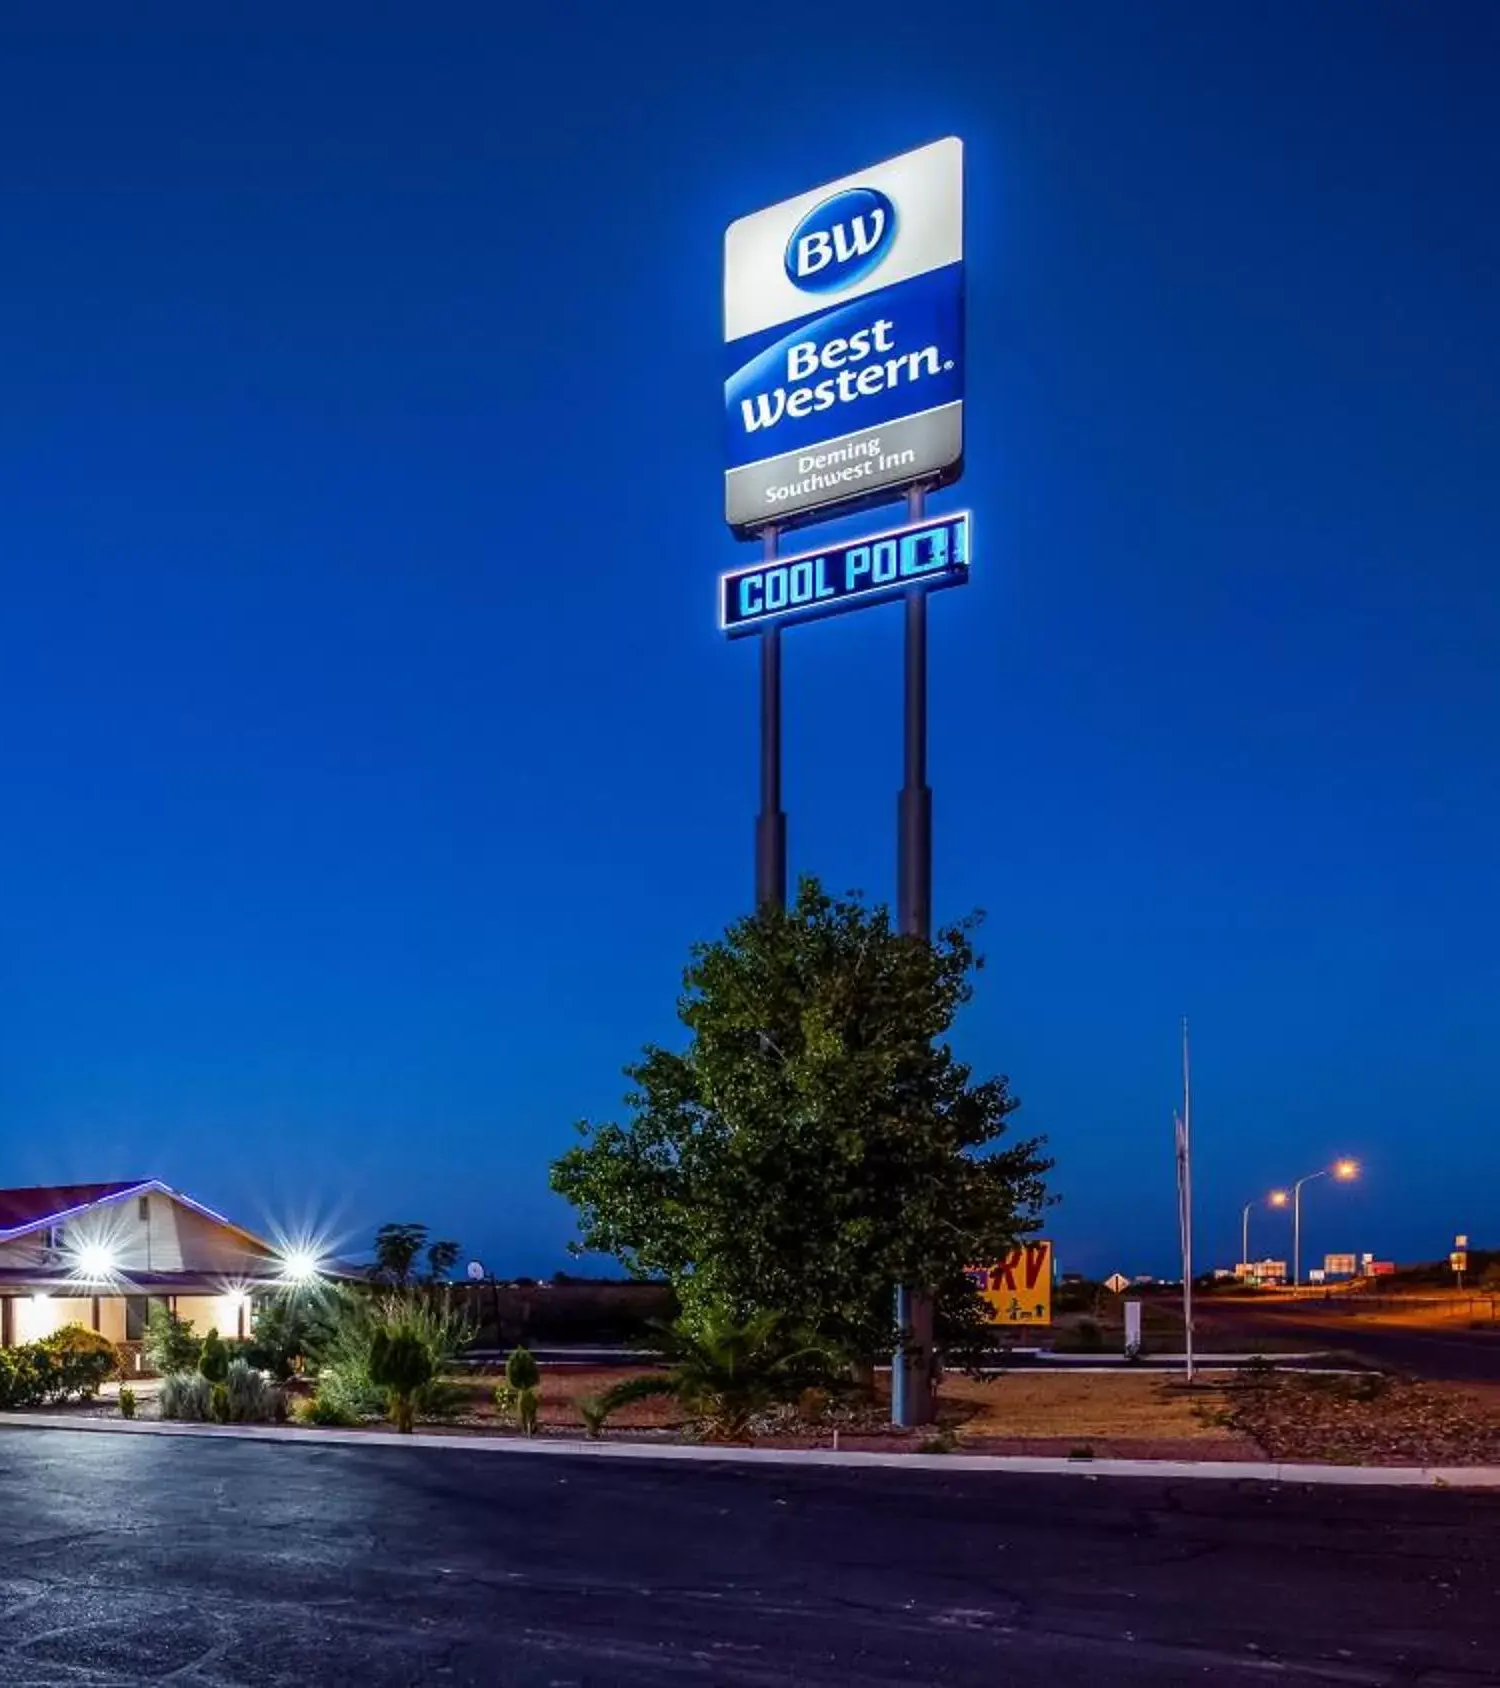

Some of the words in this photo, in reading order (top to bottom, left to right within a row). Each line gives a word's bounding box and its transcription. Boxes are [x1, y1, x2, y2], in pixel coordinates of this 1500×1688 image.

[797, 207, 885, 277] BW
[787, 319, 895, 382] Best
[764, 459, 874, 503] Southwest
[879, 448, 916, 471] Inn
[798, 437, 882, 474] Deming
[739, 557, 835, 617] COOL
[991, 1245, 1048, 1291] RV
